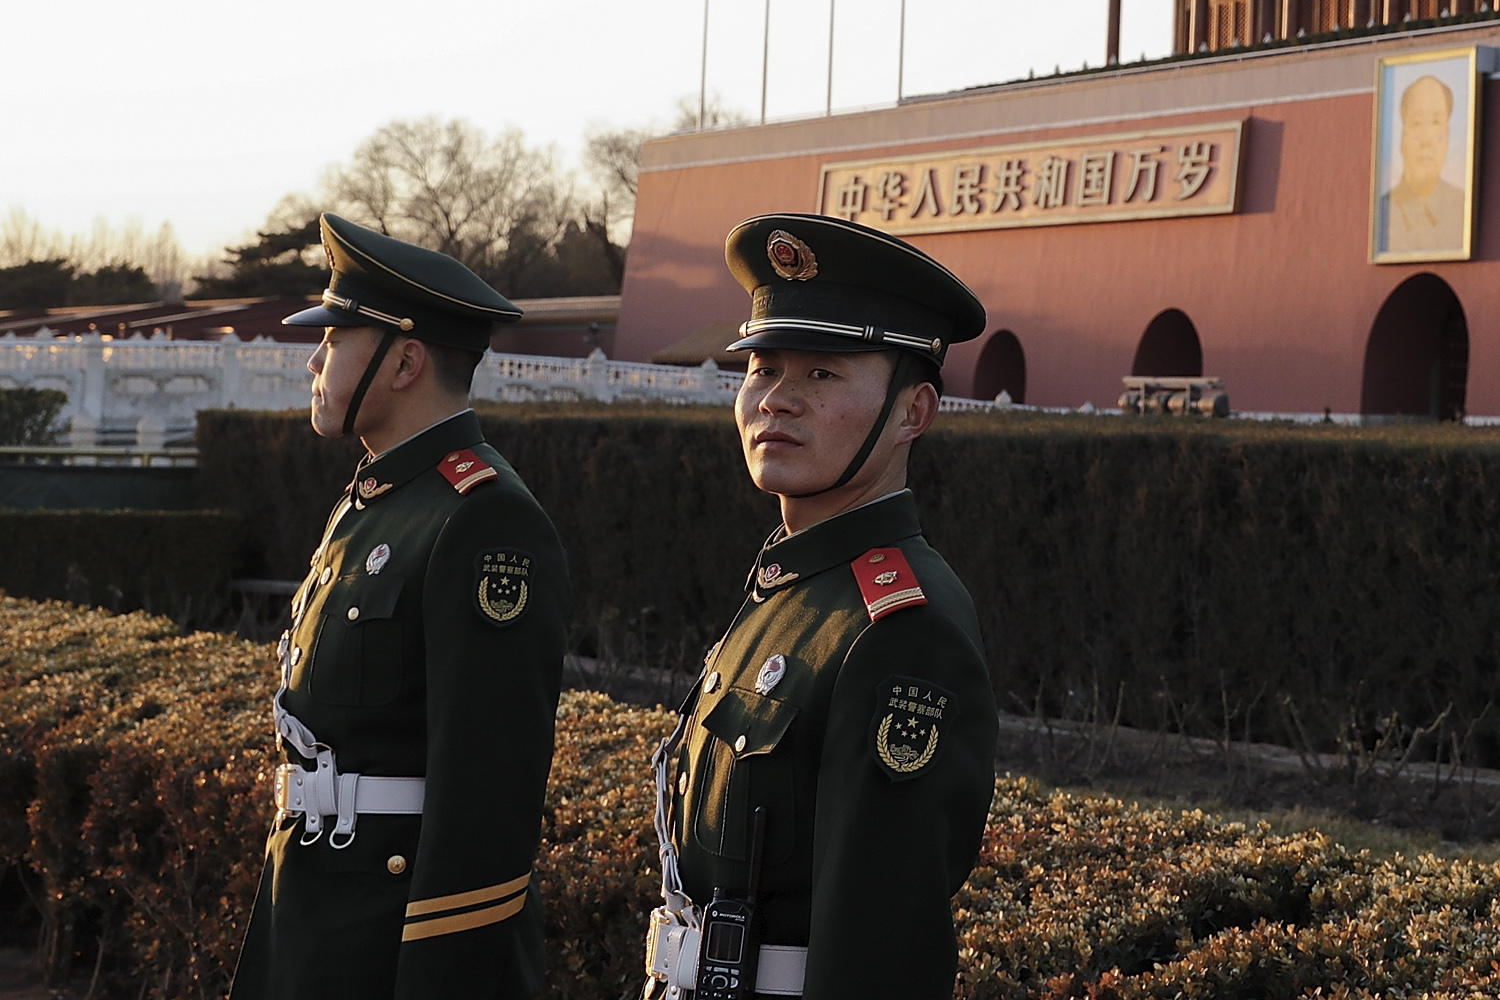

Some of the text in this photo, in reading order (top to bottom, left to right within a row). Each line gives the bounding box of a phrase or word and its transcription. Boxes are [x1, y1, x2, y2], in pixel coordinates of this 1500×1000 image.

[837, 141, 1210, 221] 中华人民共和国万岁
[484, 553, 530, 567] 中国人民
[892, 685, 947, 708] 中国人民
[888, 697, 942, 719] 武装警察部队
